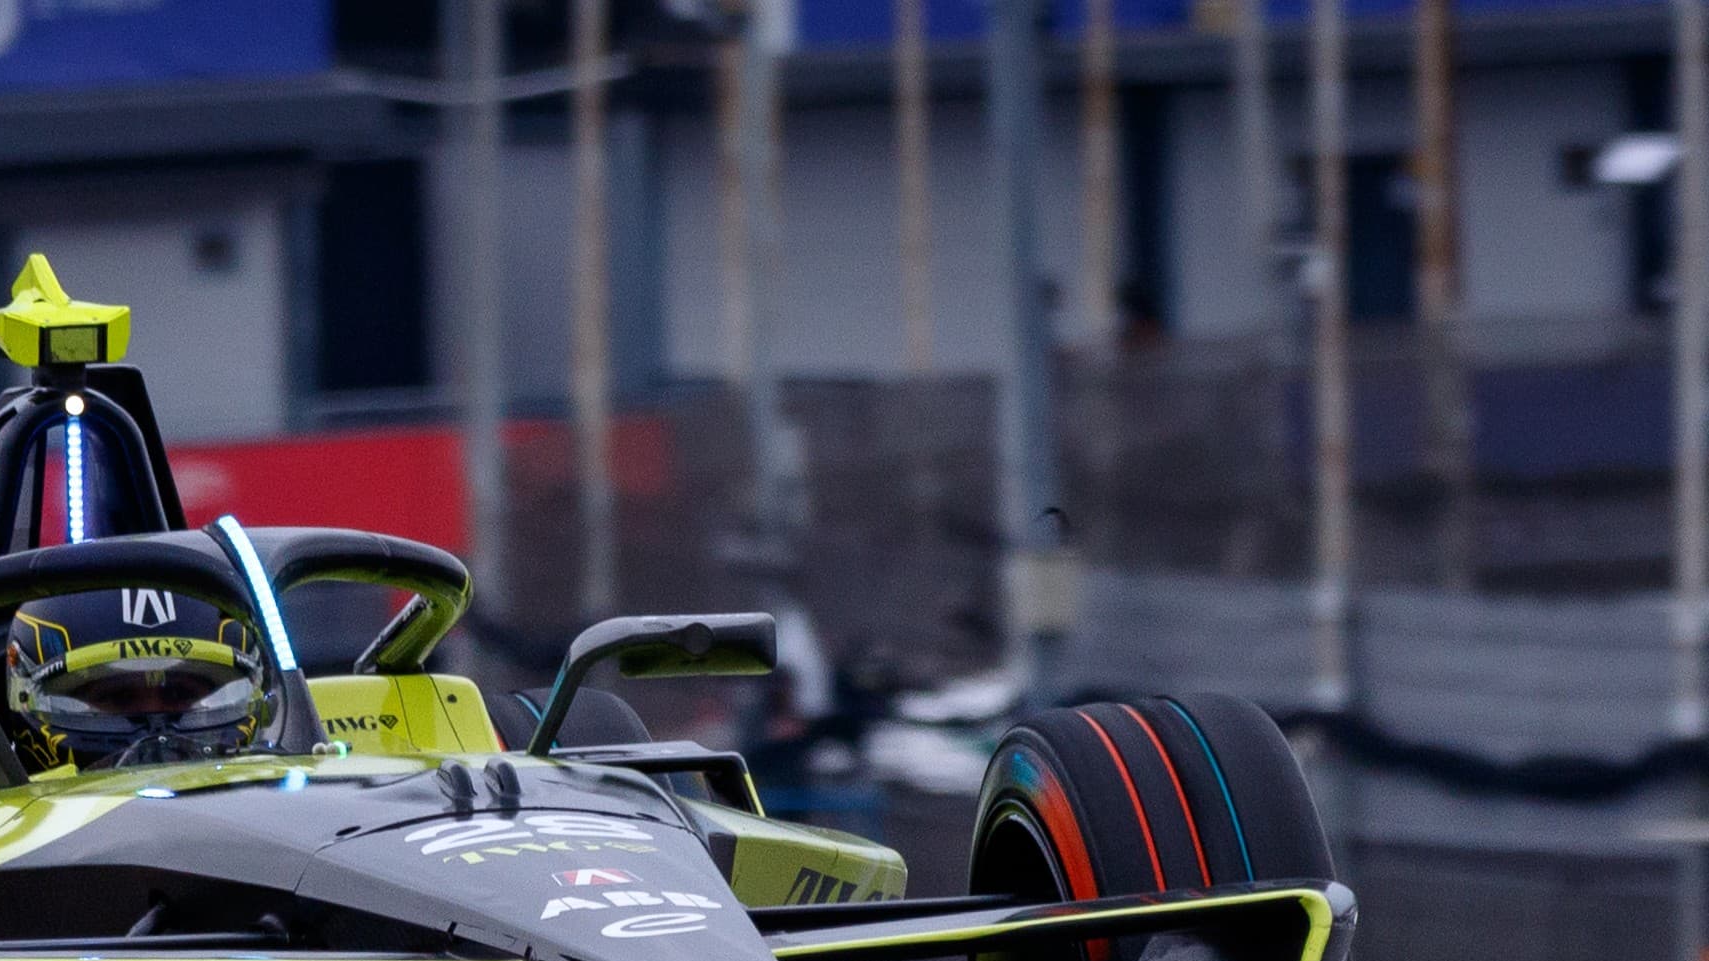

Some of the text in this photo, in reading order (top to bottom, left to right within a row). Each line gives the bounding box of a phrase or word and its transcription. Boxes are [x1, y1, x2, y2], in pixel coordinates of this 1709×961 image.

[112, 639, 172, 660] TWG
[321, 715, 378, 735] TWG
[404, 815, 654, 856] 28
[540, 891, 722, 921] ABB
